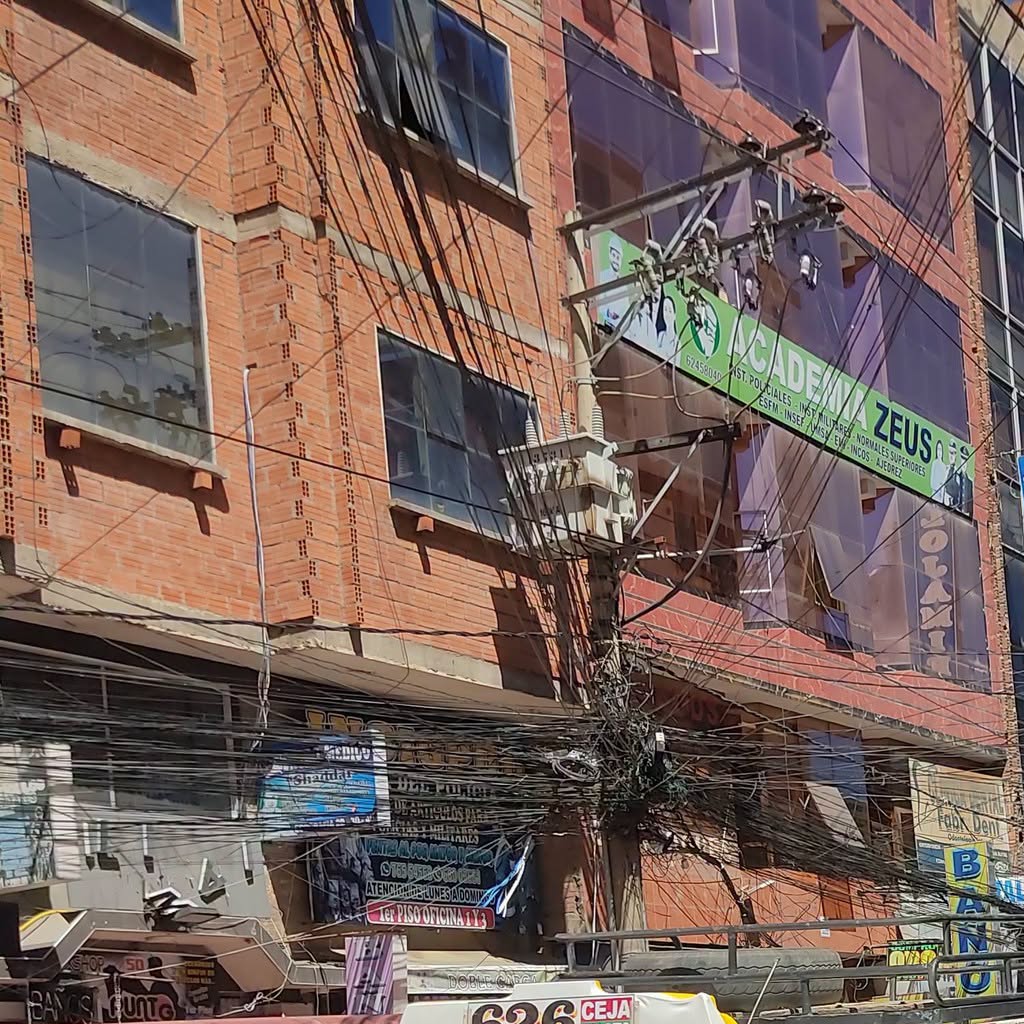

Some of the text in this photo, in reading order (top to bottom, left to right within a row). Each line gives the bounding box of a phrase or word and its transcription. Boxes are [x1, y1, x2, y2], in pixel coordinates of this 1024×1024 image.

[749, 373, 792, 407] POLICIALES
[856, 432, 890, 459] NORMALES
[890, 449, 926, 478] SUPERIORES
[759, 395, 779, 414] ESFM
[850, 444, 870, 462] INCOS
[876, 457, 903, 479] AJEDREZ
[873, 400, 932, 464] ZEUS
[396, 904, 421, 923] PISO
[422, 905, 464, 927] OFICINA
[580, 1000, 631, 1021] CEJA
